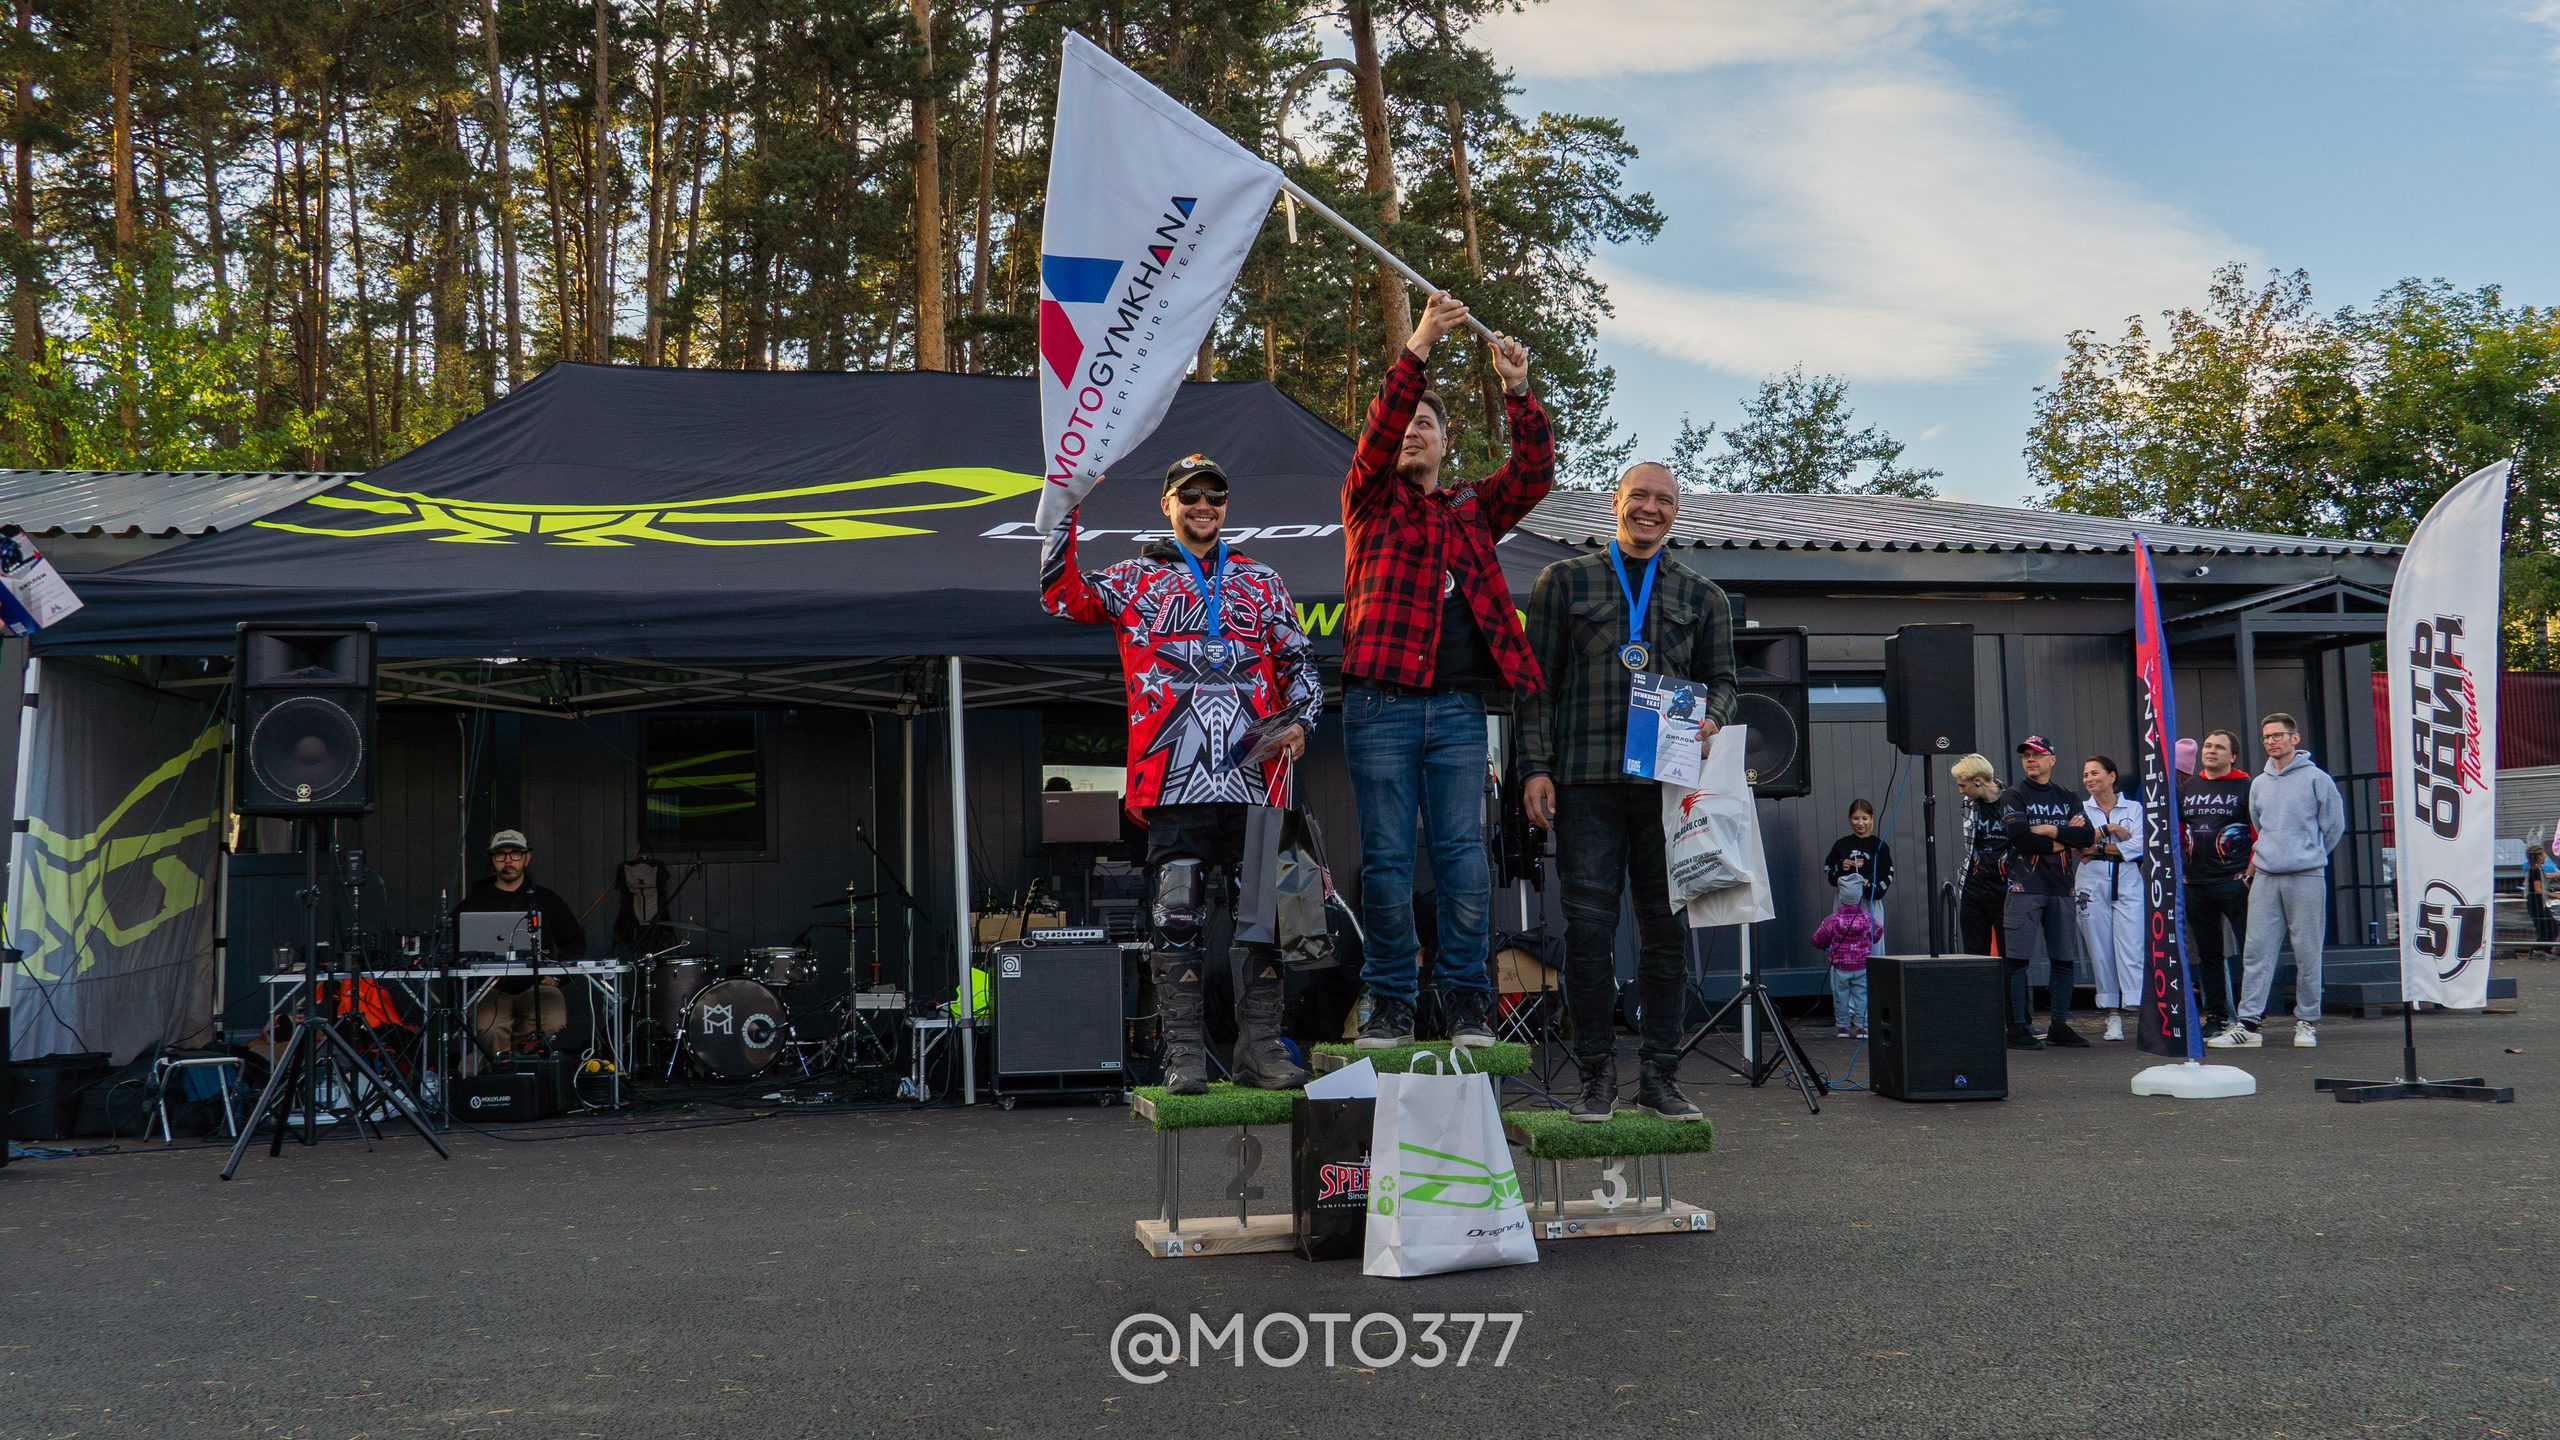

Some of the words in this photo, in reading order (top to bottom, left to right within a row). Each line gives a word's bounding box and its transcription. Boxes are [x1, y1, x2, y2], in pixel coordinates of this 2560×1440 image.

[1047, 196, 1198, 488] MOTOGYMKHANA
[1087, 299, 1169, 478] EKATERINBURG
[1171, 223, 1206, 281] TEAM
[1665, 733, 1695, 744] ДИПЛОМ
[2182, 793, 2238, 807] ММАЙ
[2197, 807, 2233, 817] ПРОФИ
[2413, 900, 2488, 961] 51
[1225, 1133, 1265, 1200] 2
[1592, 1155, 1628, 1209] 3
[1347, 1192, 1369, 1200] Since
